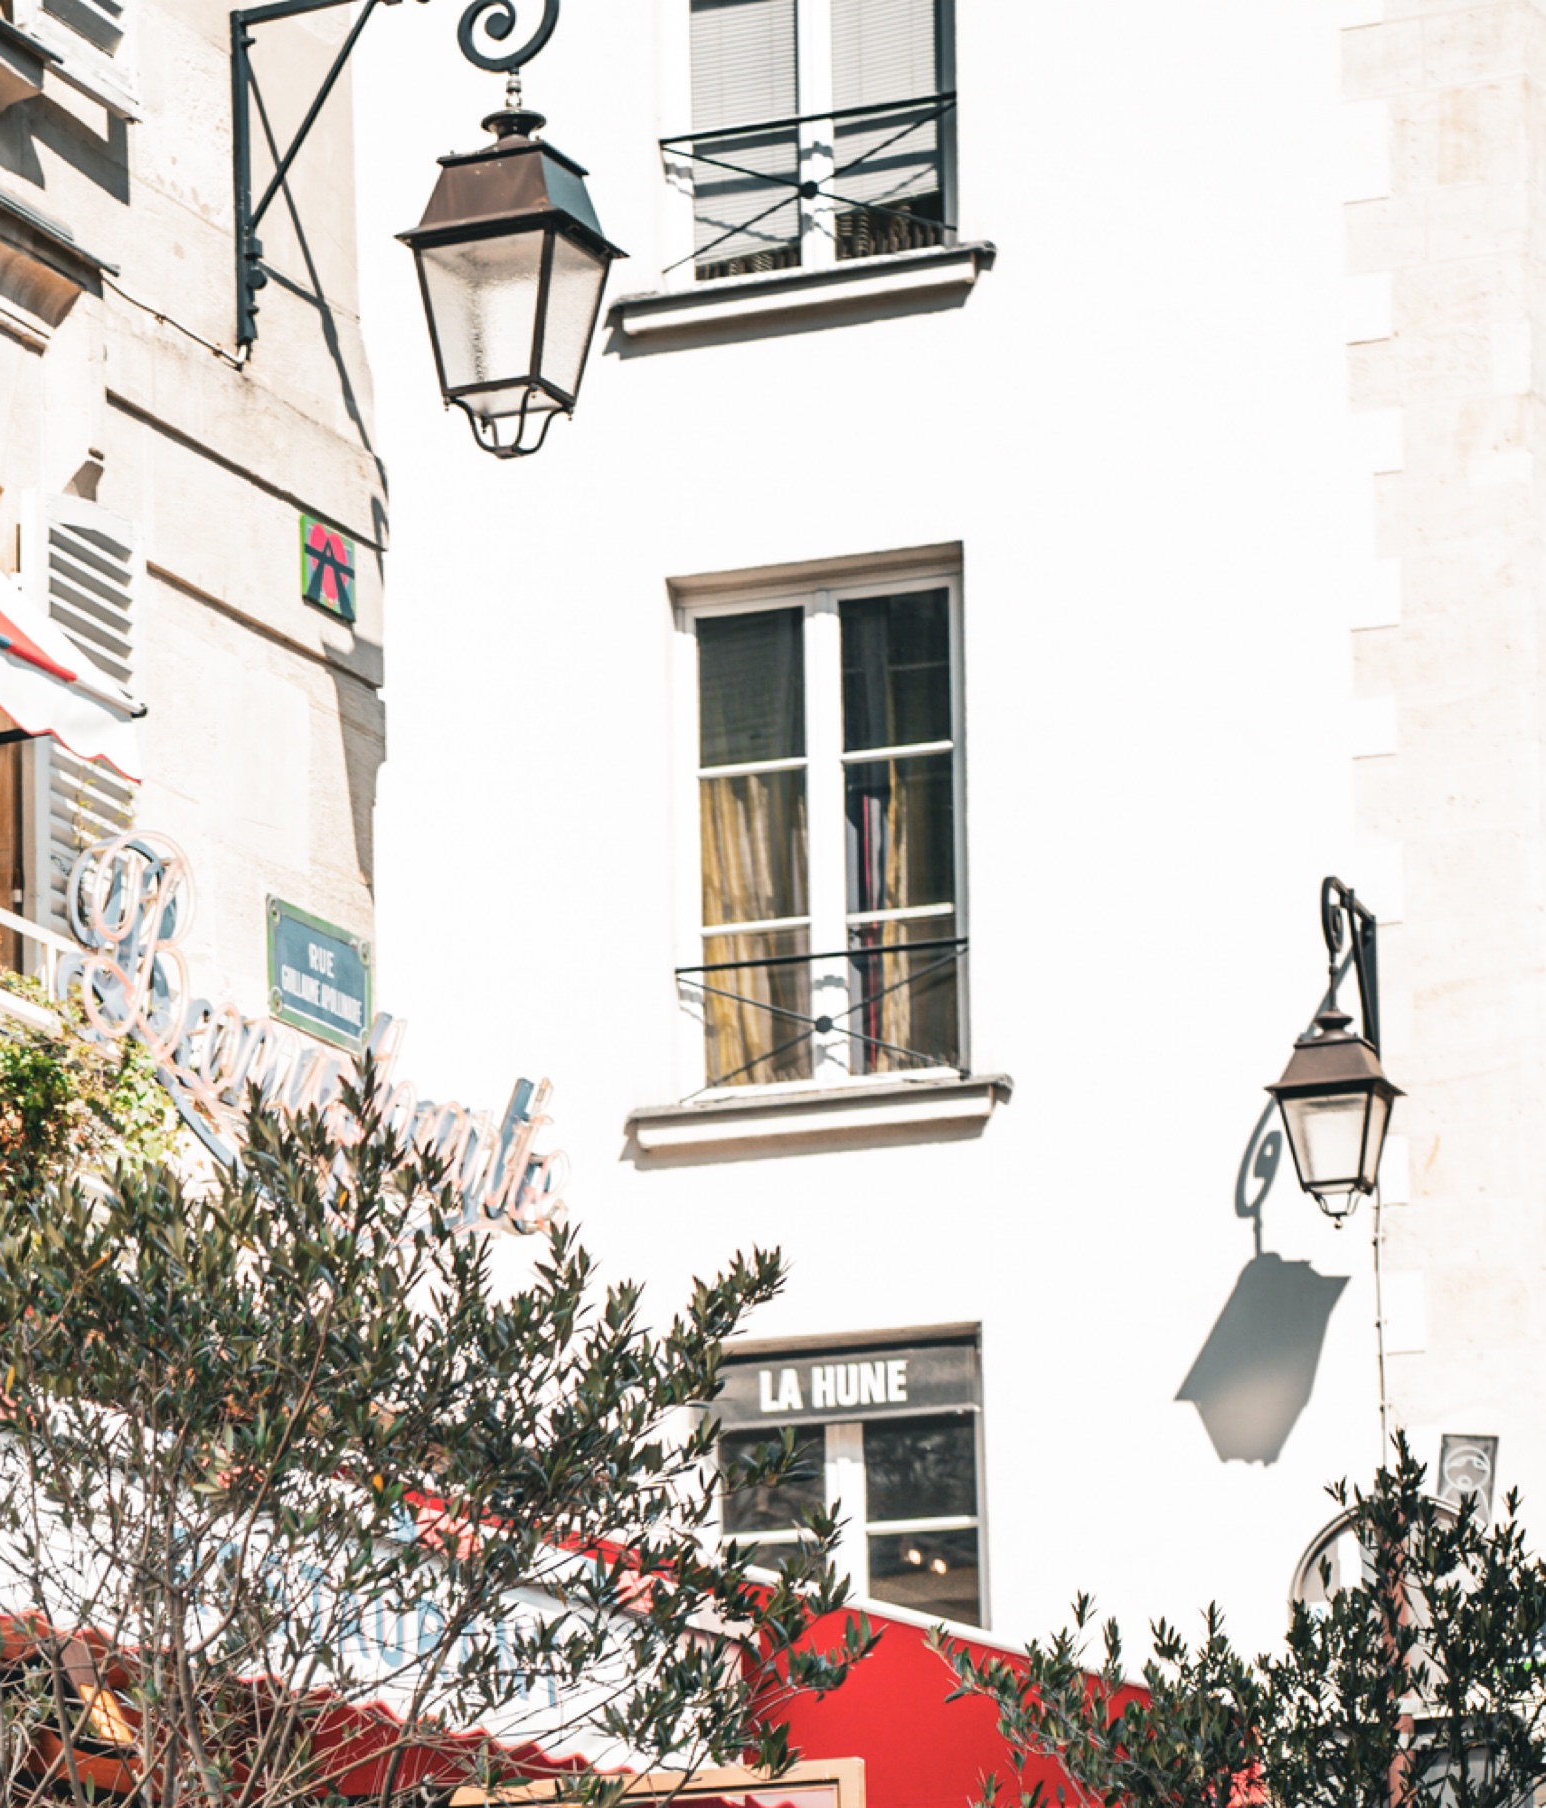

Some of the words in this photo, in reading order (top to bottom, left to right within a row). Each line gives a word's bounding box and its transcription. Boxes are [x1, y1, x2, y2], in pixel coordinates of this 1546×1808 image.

[308, 942, 336, 979] RUE
[759, 1367, 804, 1413] LA
[811, 1359, 909, 1409] HUNE
